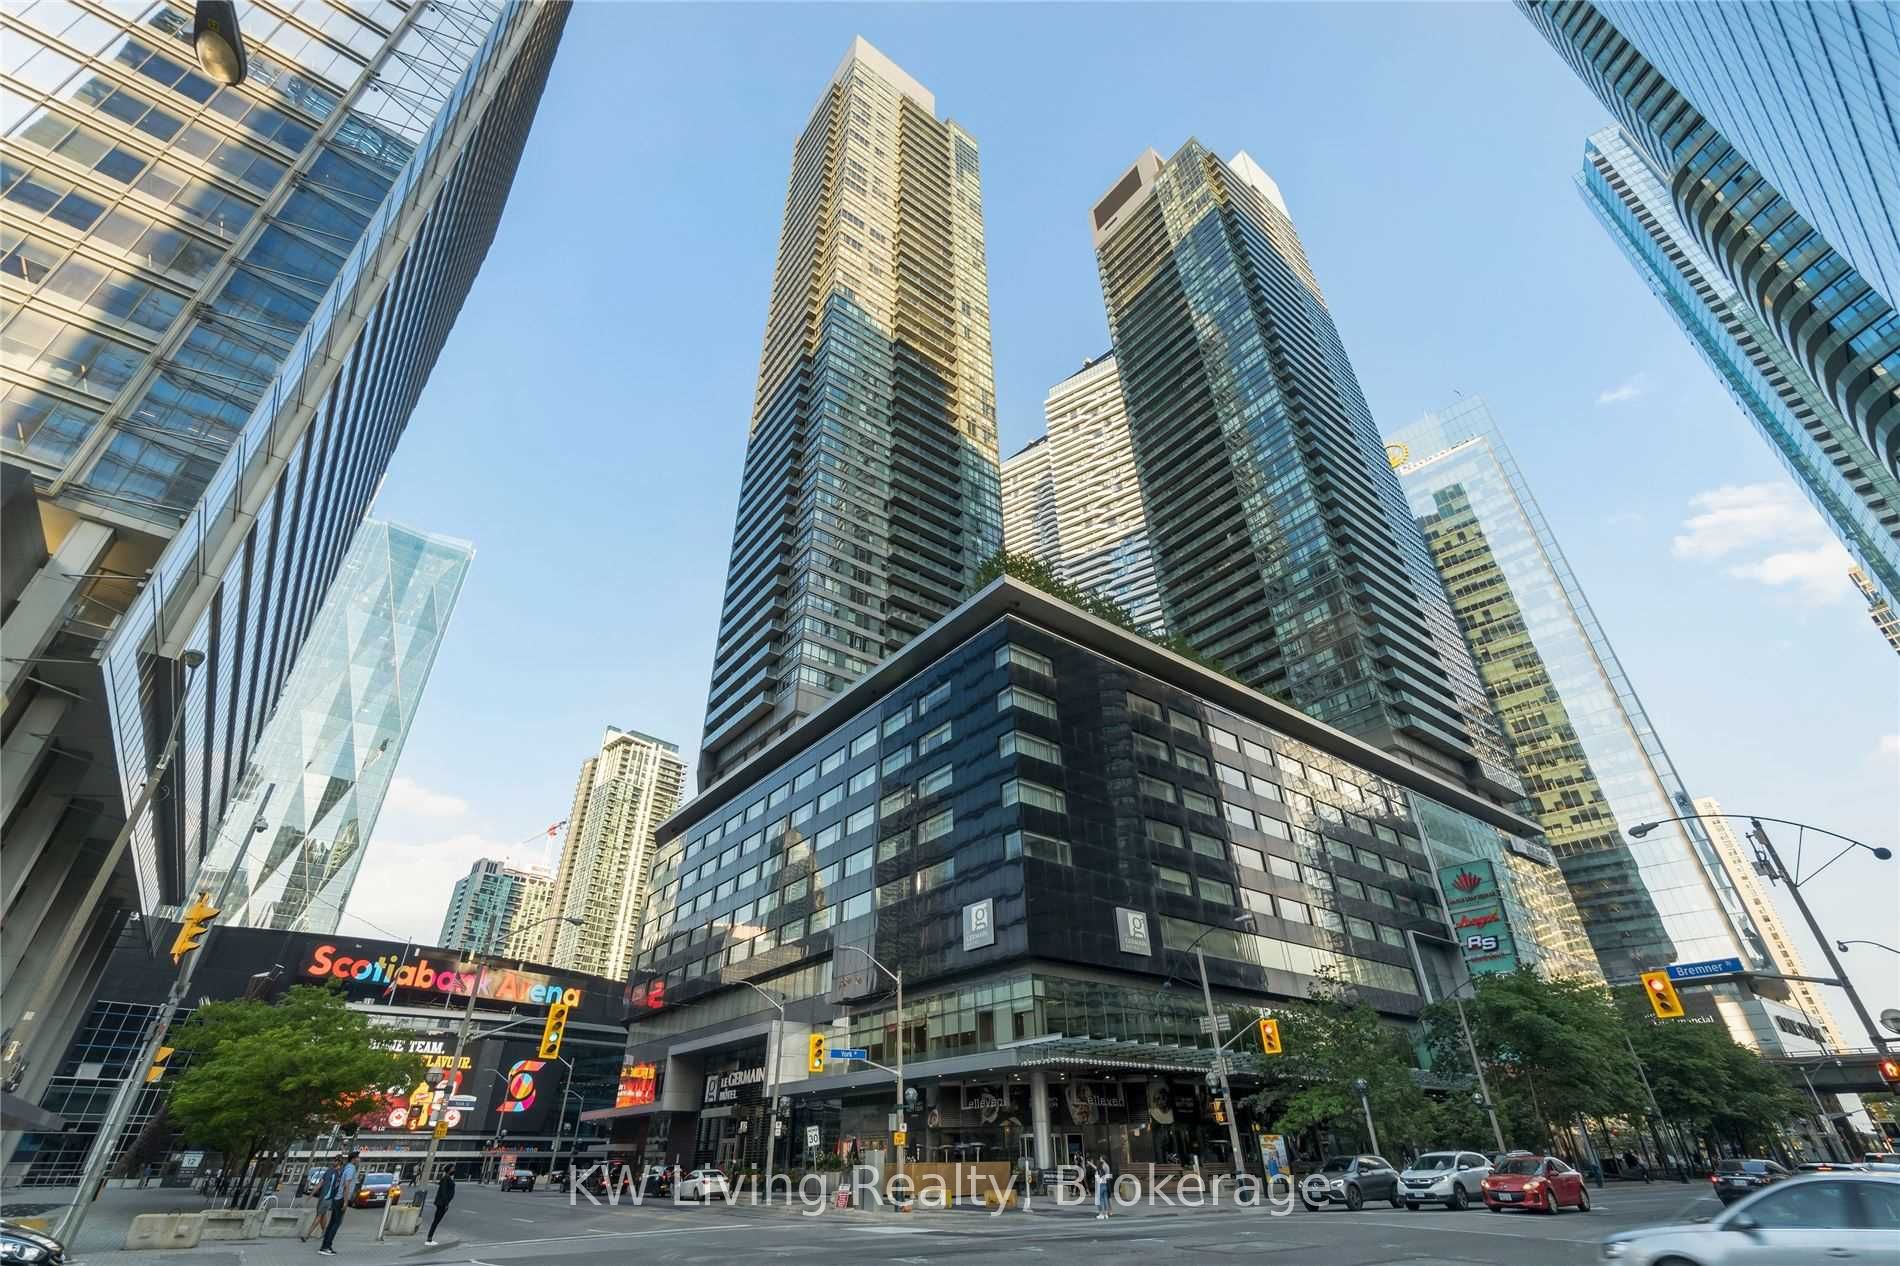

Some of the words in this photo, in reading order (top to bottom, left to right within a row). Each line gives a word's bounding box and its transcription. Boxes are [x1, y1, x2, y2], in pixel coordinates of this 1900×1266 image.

[1467, 935, 1498, 950] RS
[1676, 963, 1723, 977] Bremner
[495, 971, 581, 1007] Arena
[408, 1040, 445, 1054] TEAM.
[841, 1050, 853, 1058] York
[729, 1067, 766, 1086] GERMAIN
[809, 1134, 818, 1144] 30
